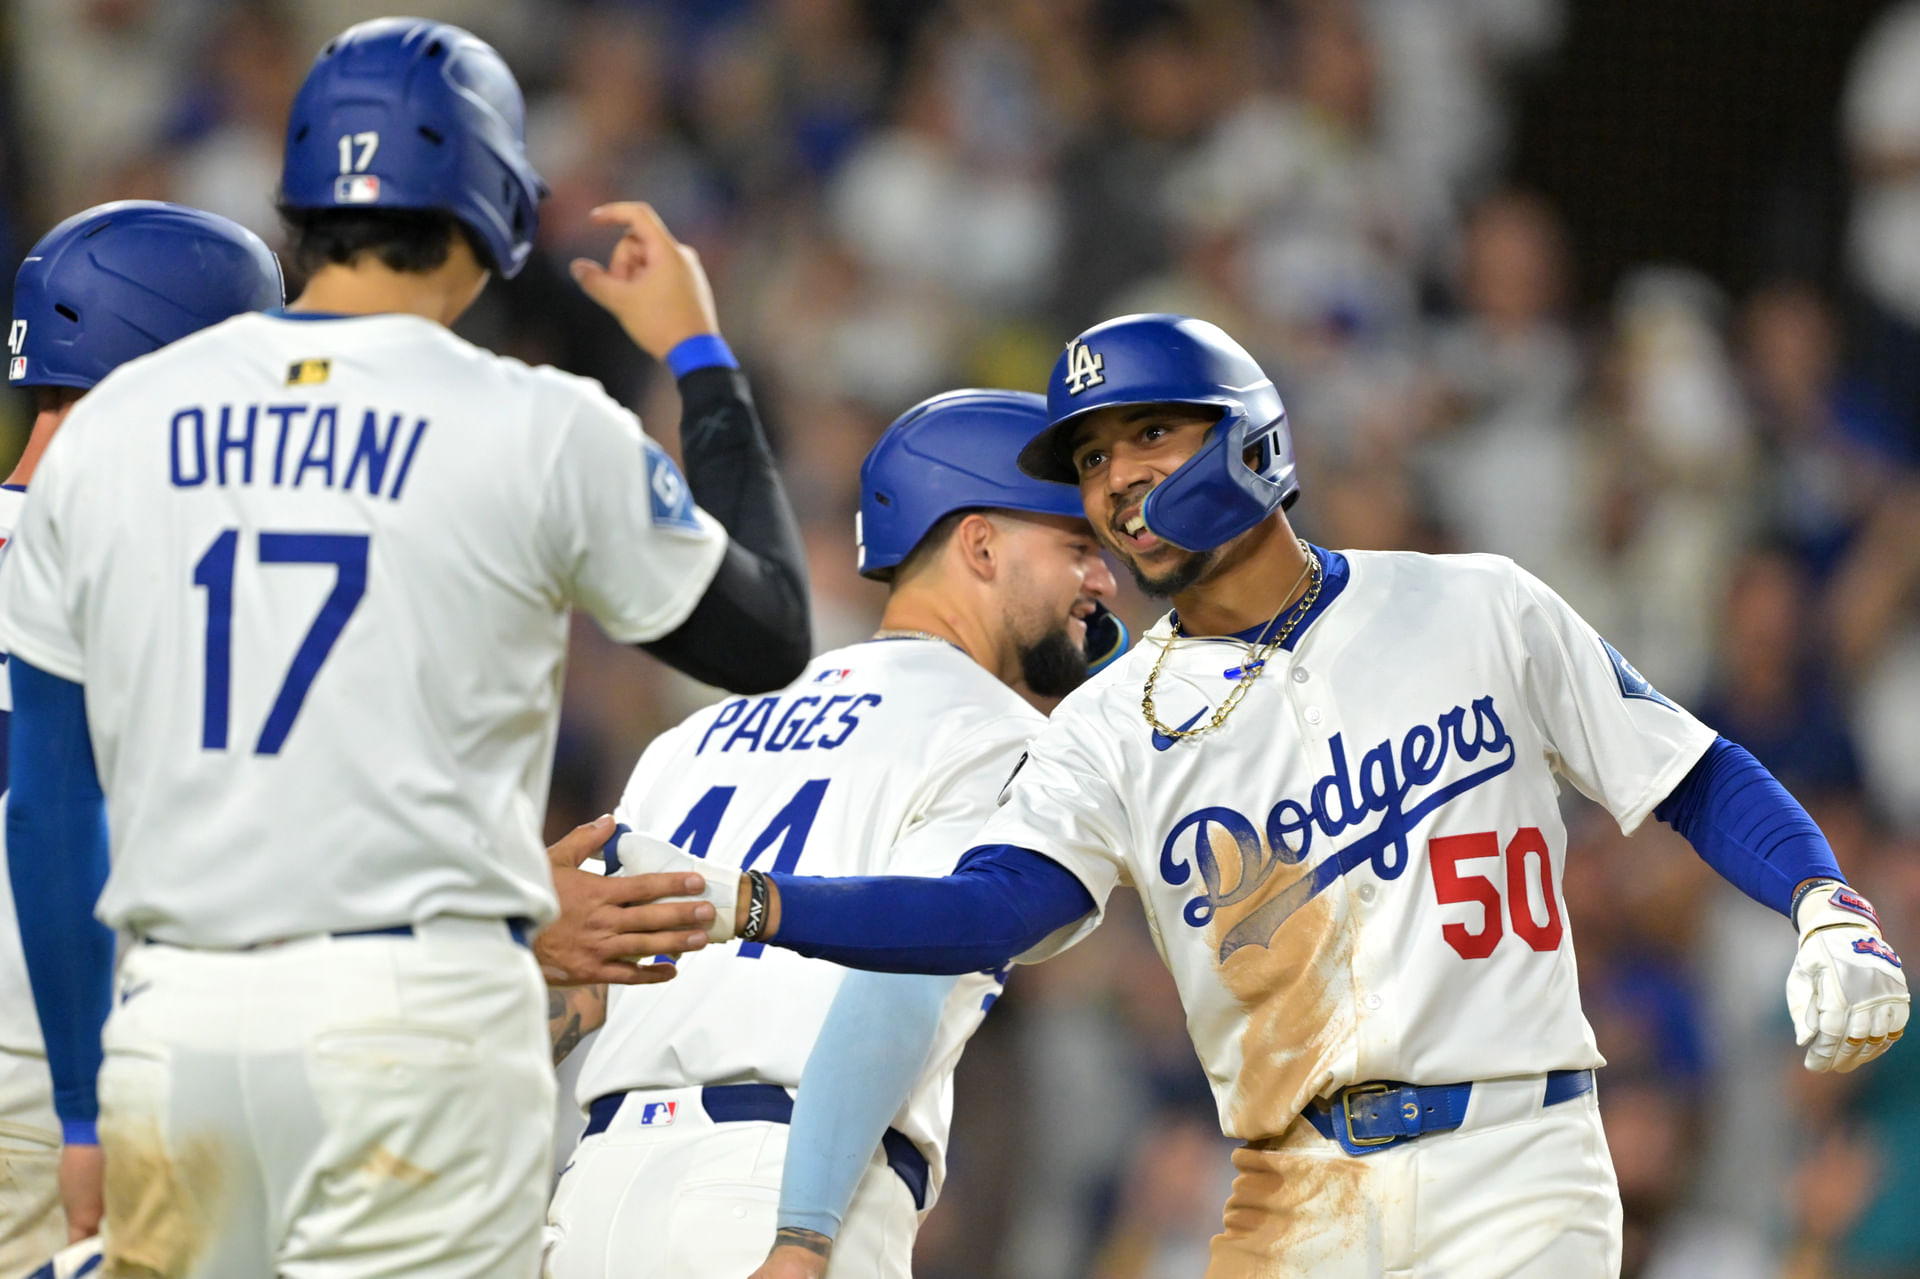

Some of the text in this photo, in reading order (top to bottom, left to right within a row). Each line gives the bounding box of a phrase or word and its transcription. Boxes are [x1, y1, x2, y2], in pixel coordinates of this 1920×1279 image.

[338, 131, 379, 174] 17
[8, 319, 28, 355] 47
[1065, 337, 1104, 396] LA
[169, 403, 429, 501] OHTANI
[192, 527, 370, 757] 17
[696, 693, 882, 756] PAGES
[1159, 694, 1516, 928] Dodgers
[1428, 827, 1563, 960] 50
